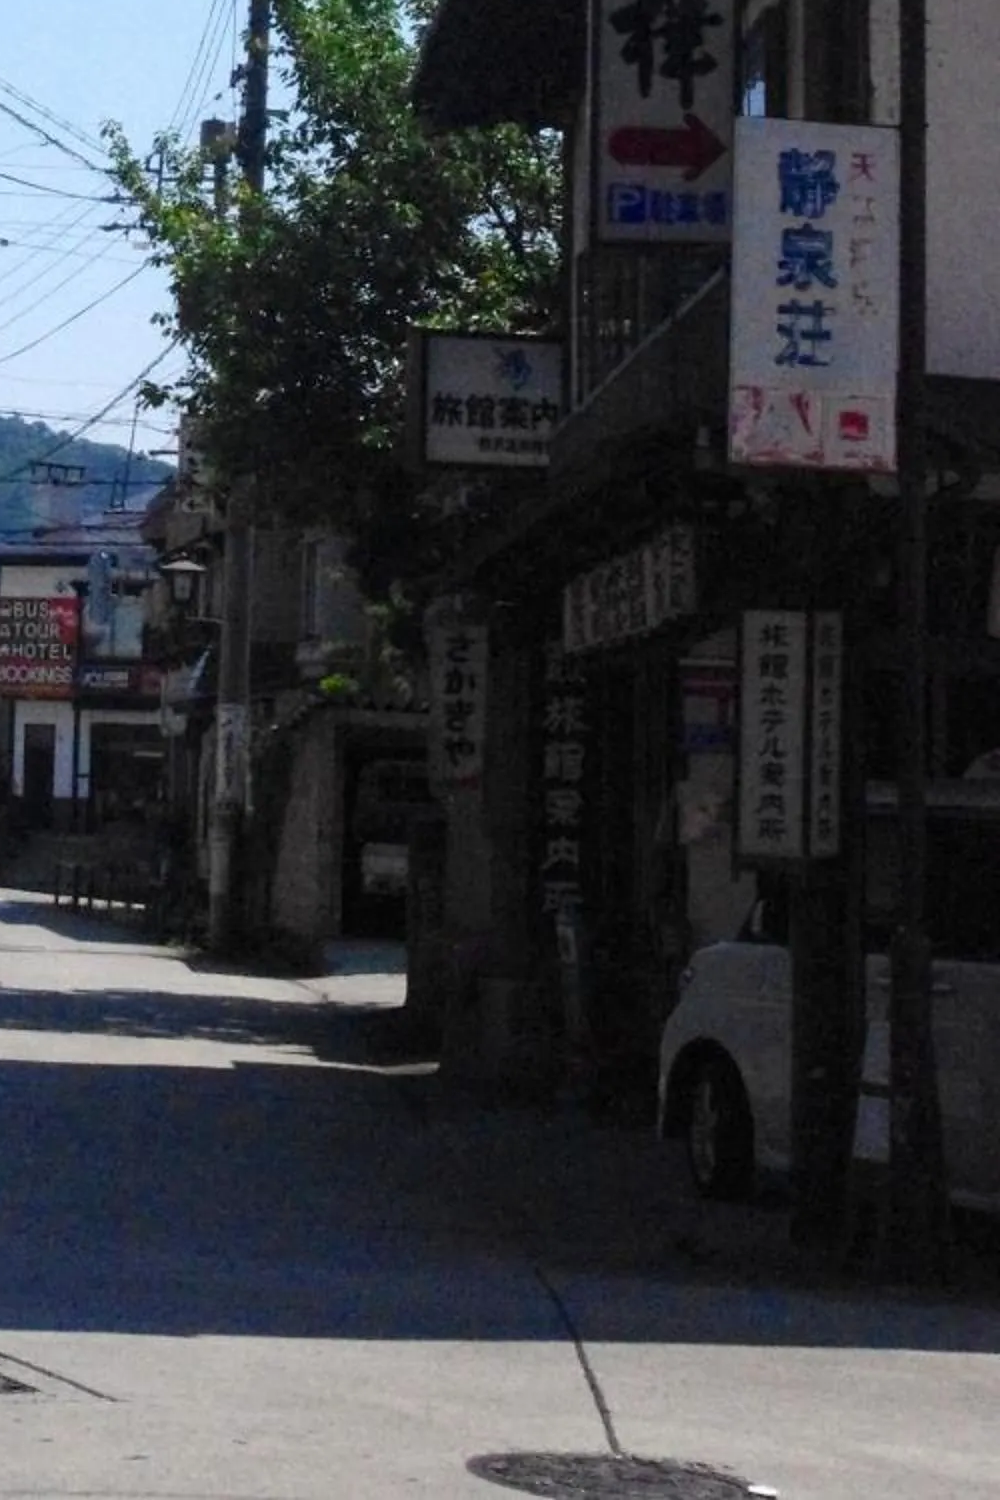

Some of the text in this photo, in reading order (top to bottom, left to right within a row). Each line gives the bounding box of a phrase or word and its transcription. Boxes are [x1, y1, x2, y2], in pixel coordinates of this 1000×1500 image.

[13, 601, 50, 618] BUS
[13, 623, 61, 639] TOUR
[12, 643, 73, 660] HOTEL
